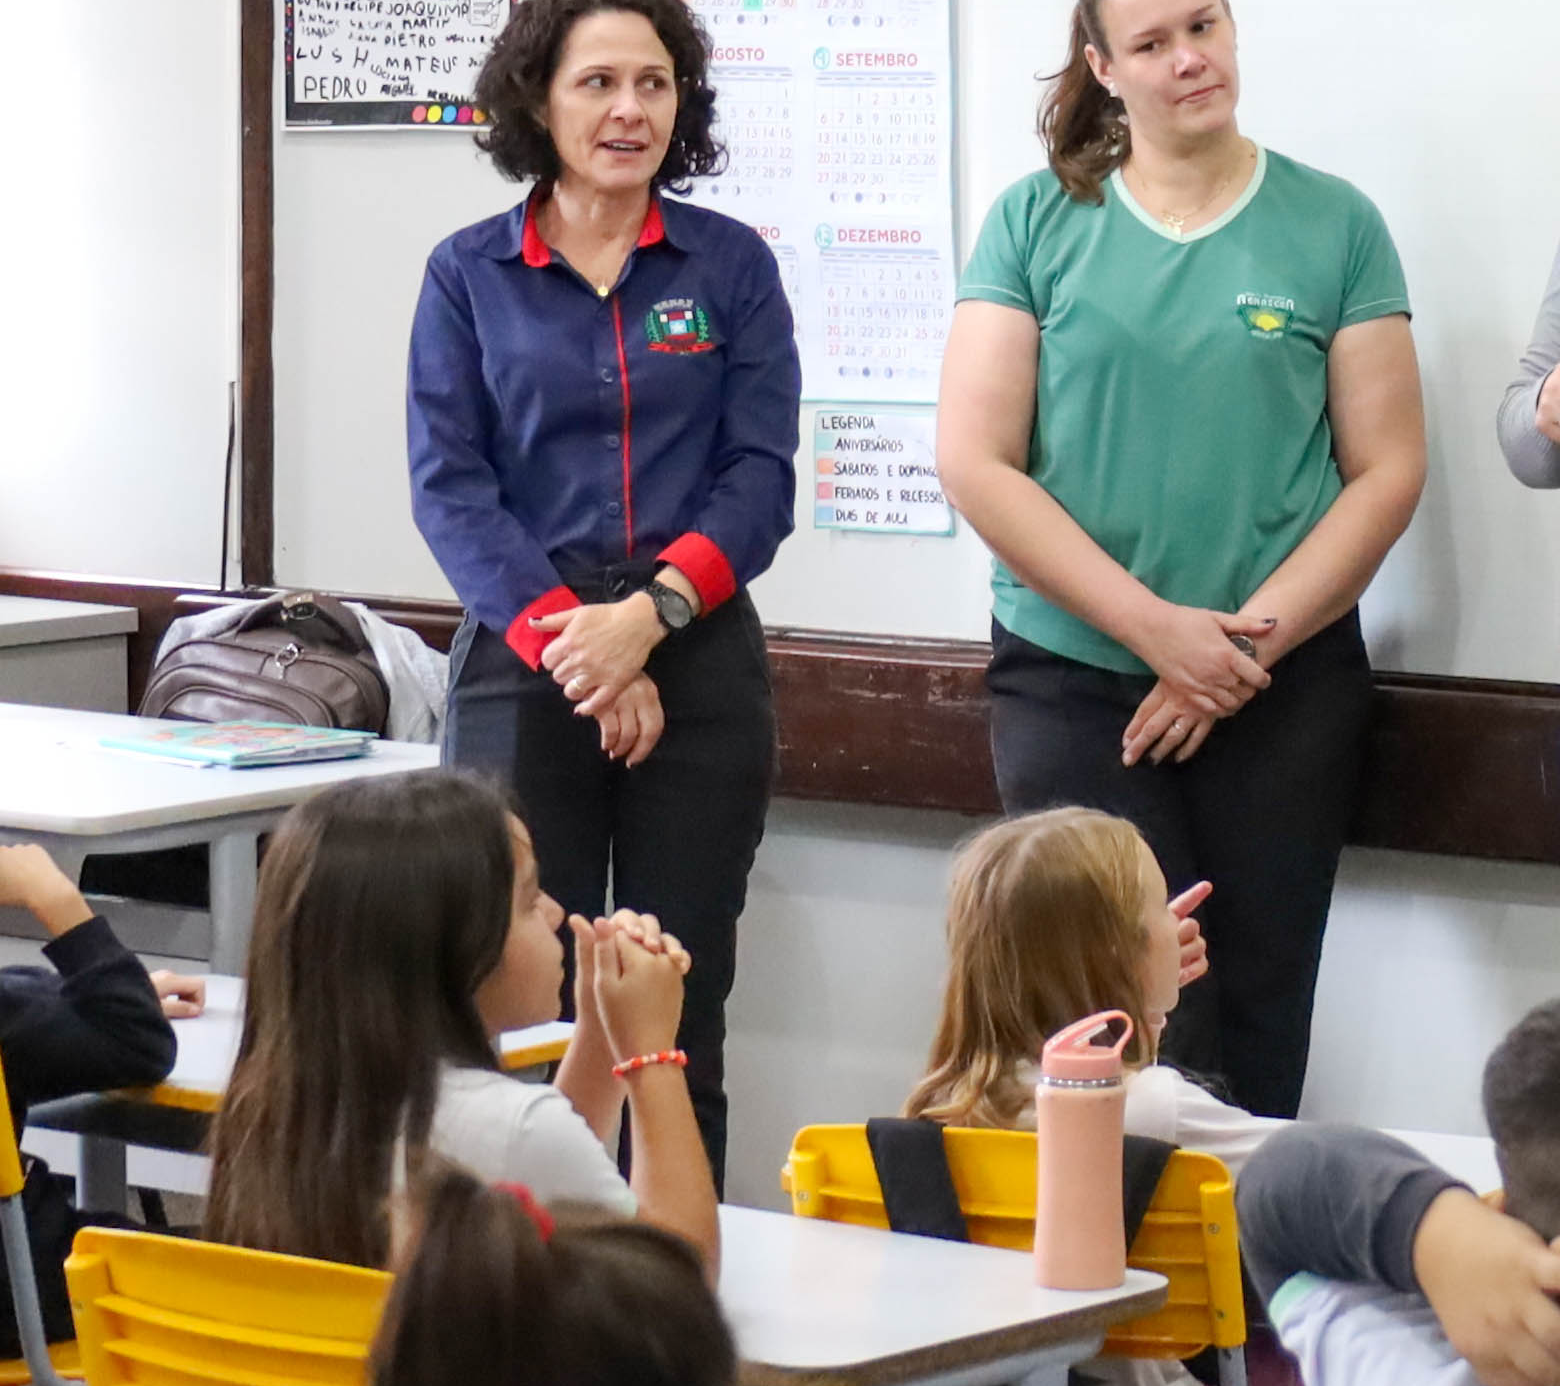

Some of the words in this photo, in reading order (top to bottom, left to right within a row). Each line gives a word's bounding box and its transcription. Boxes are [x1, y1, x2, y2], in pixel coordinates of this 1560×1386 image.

[836, 53, 918, 66] SETEMBRO
[839, 229, 921, 243] DEZEMBRO
[822, 416, 875, 429] LEGENDA
[835, 435, 903, 452] ANIVERSÁRIOS
[888, 465, 892, 477] E
[835, 487, 879, 501] FERIADOS
[887, 490, 892, 501] E
[866, 511, 877, 523] DE
[885, 513, 908, 524] AULA
